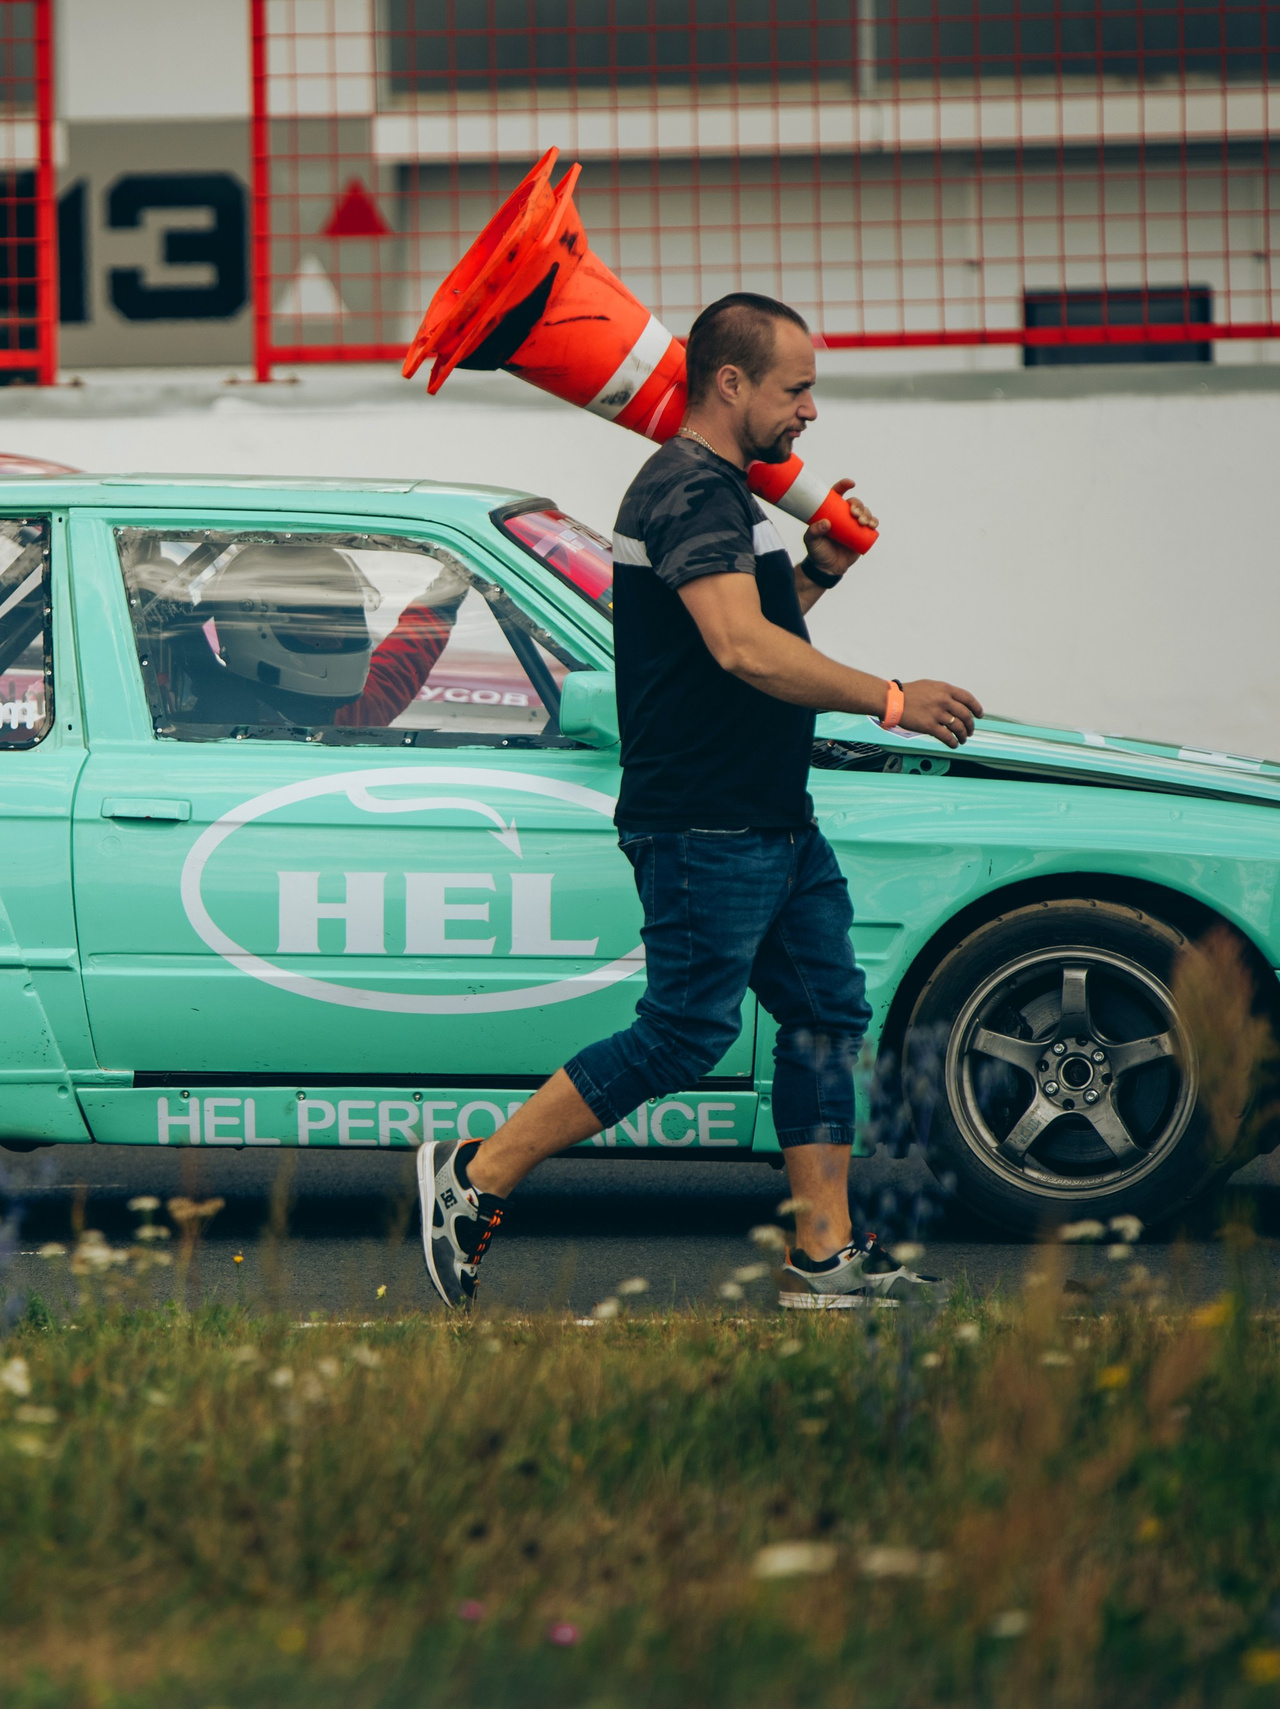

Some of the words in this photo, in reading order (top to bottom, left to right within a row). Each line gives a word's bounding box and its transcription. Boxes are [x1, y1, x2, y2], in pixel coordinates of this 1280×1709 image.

[275, 871, 600, 956] HEL
[156, 1096, 282, 1146] HEL
[296, 1099, 739, 1148] PERFONCE
